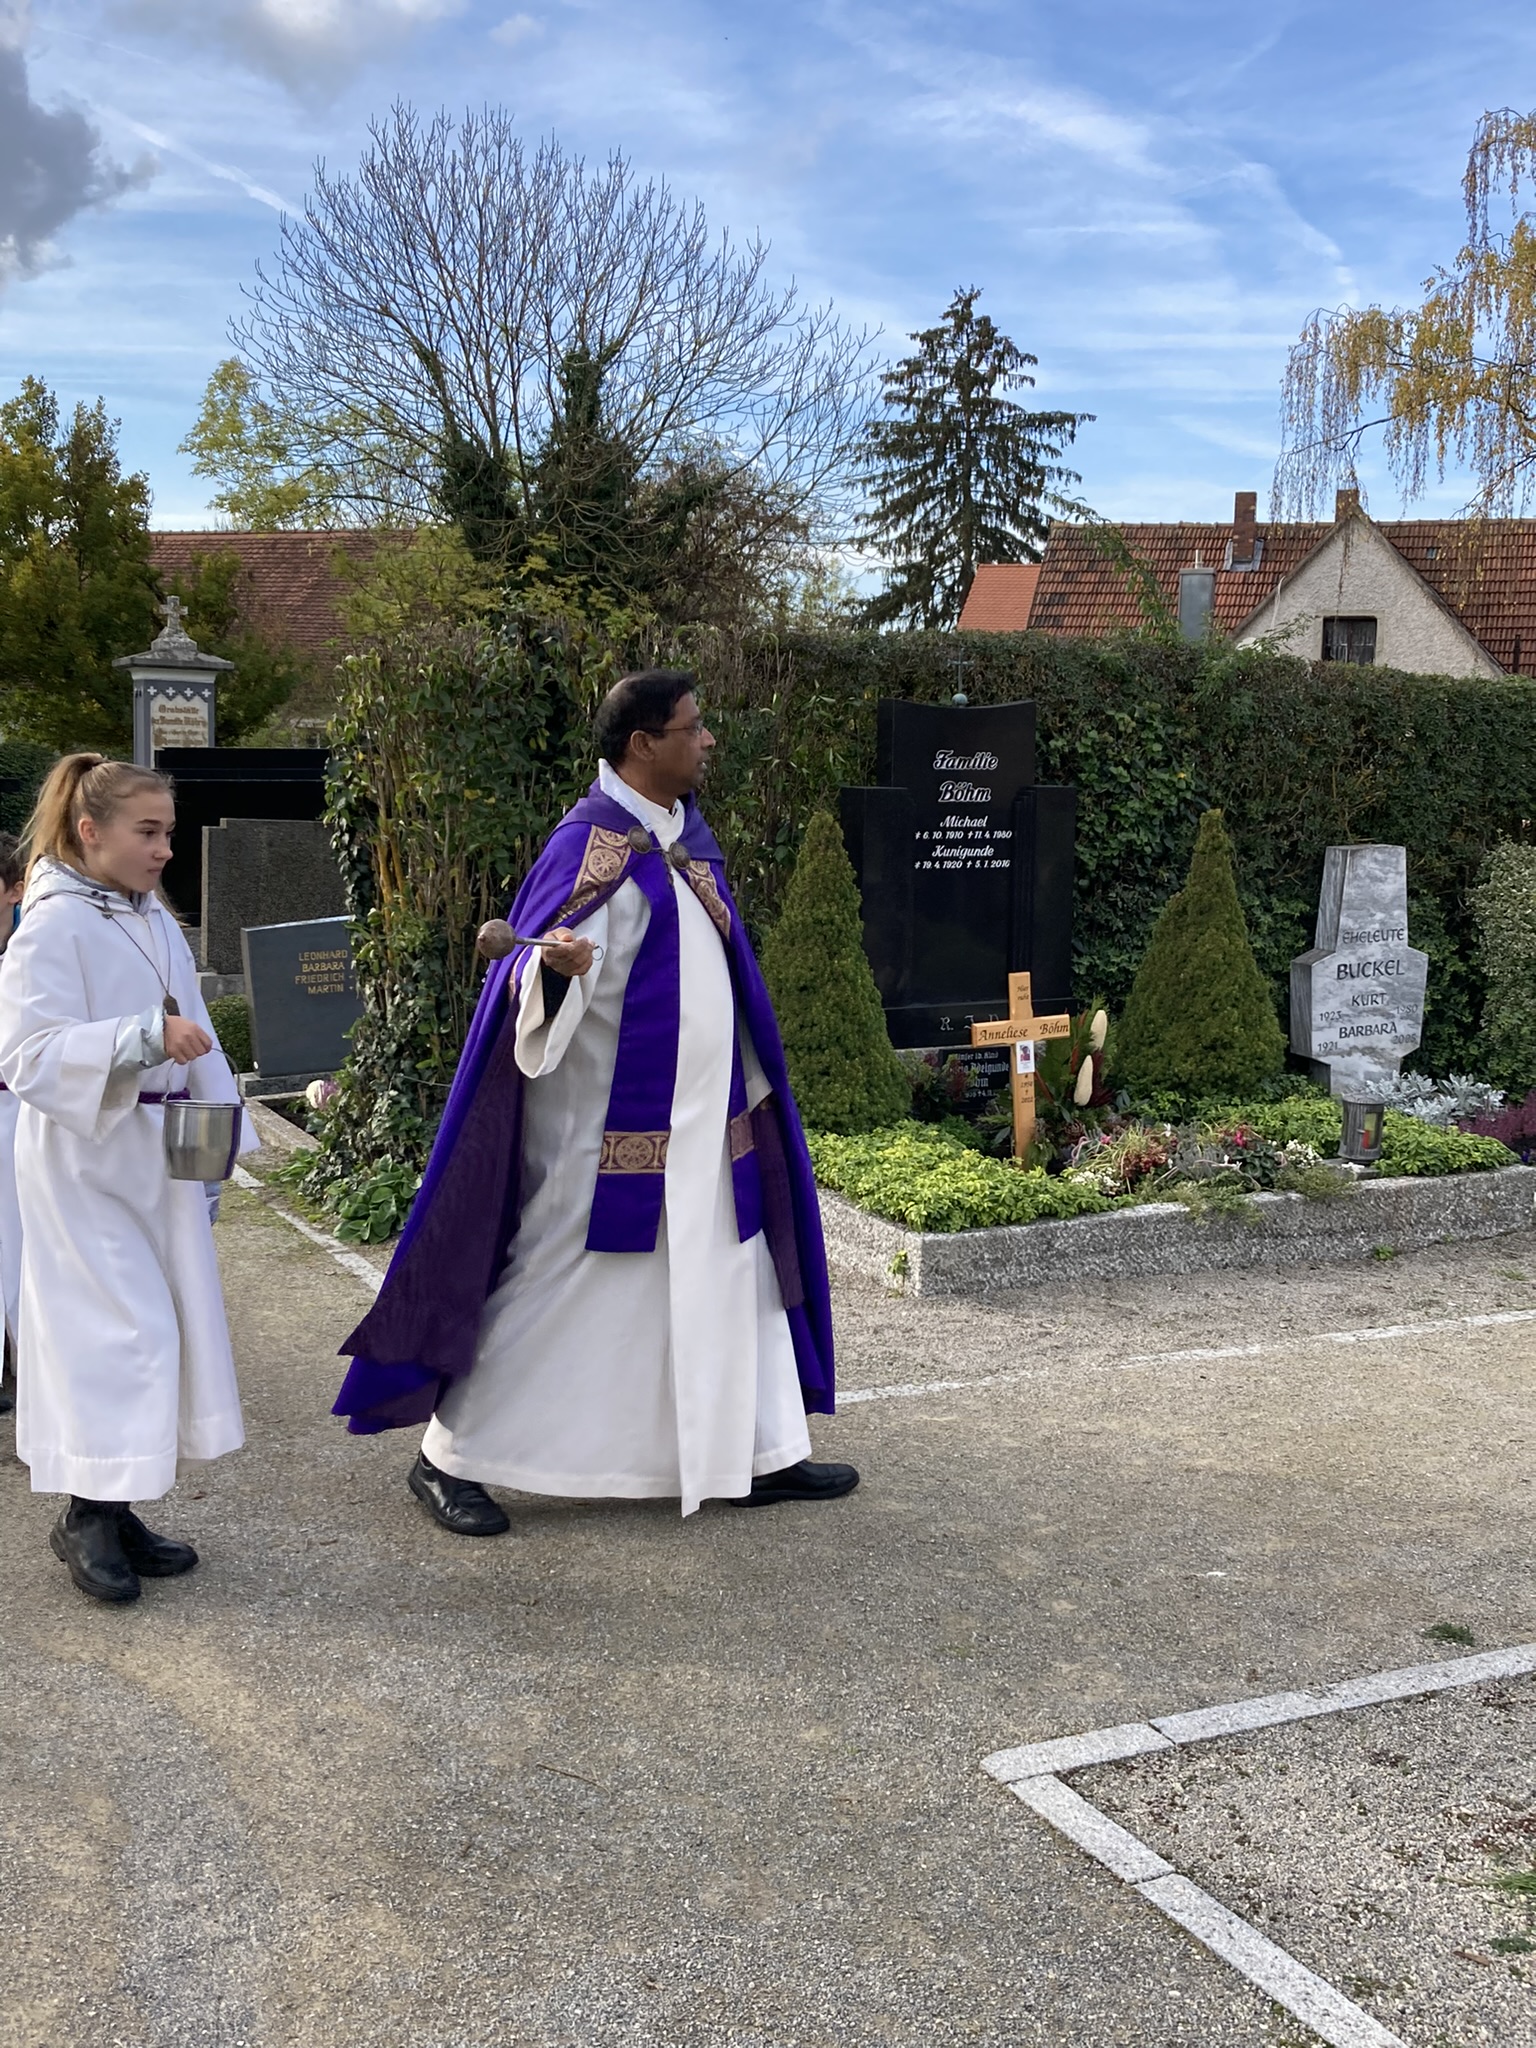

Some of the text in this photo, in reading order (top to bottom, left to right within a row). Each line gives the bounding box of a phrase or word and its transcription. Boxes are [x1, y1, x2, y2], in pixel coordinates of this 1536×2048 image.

[933, 750, 998, 770] Familie
[938, 781, 991, 802] Böhm
[940, 815, 988, 828] Michael
[932, 845, 995, 860] Kunigunde
[1342, 928, 1404, 944] EHELEUTE
[299, 950, 347, 961] LEONHARD
[302, 962, 345, 972] BARBARA
[1337, 959, 1405, 980] BUCKEL
[295, 973, 344, 984] FRIEDRICH
[308, 984, 343, 994] MARTIN
[1351, 992, 1388, 1007] KURT
[979, 1020, 1069, 1041] Anneliese Böhm
[1339, 1021, 1398, 1039] BARBARA
